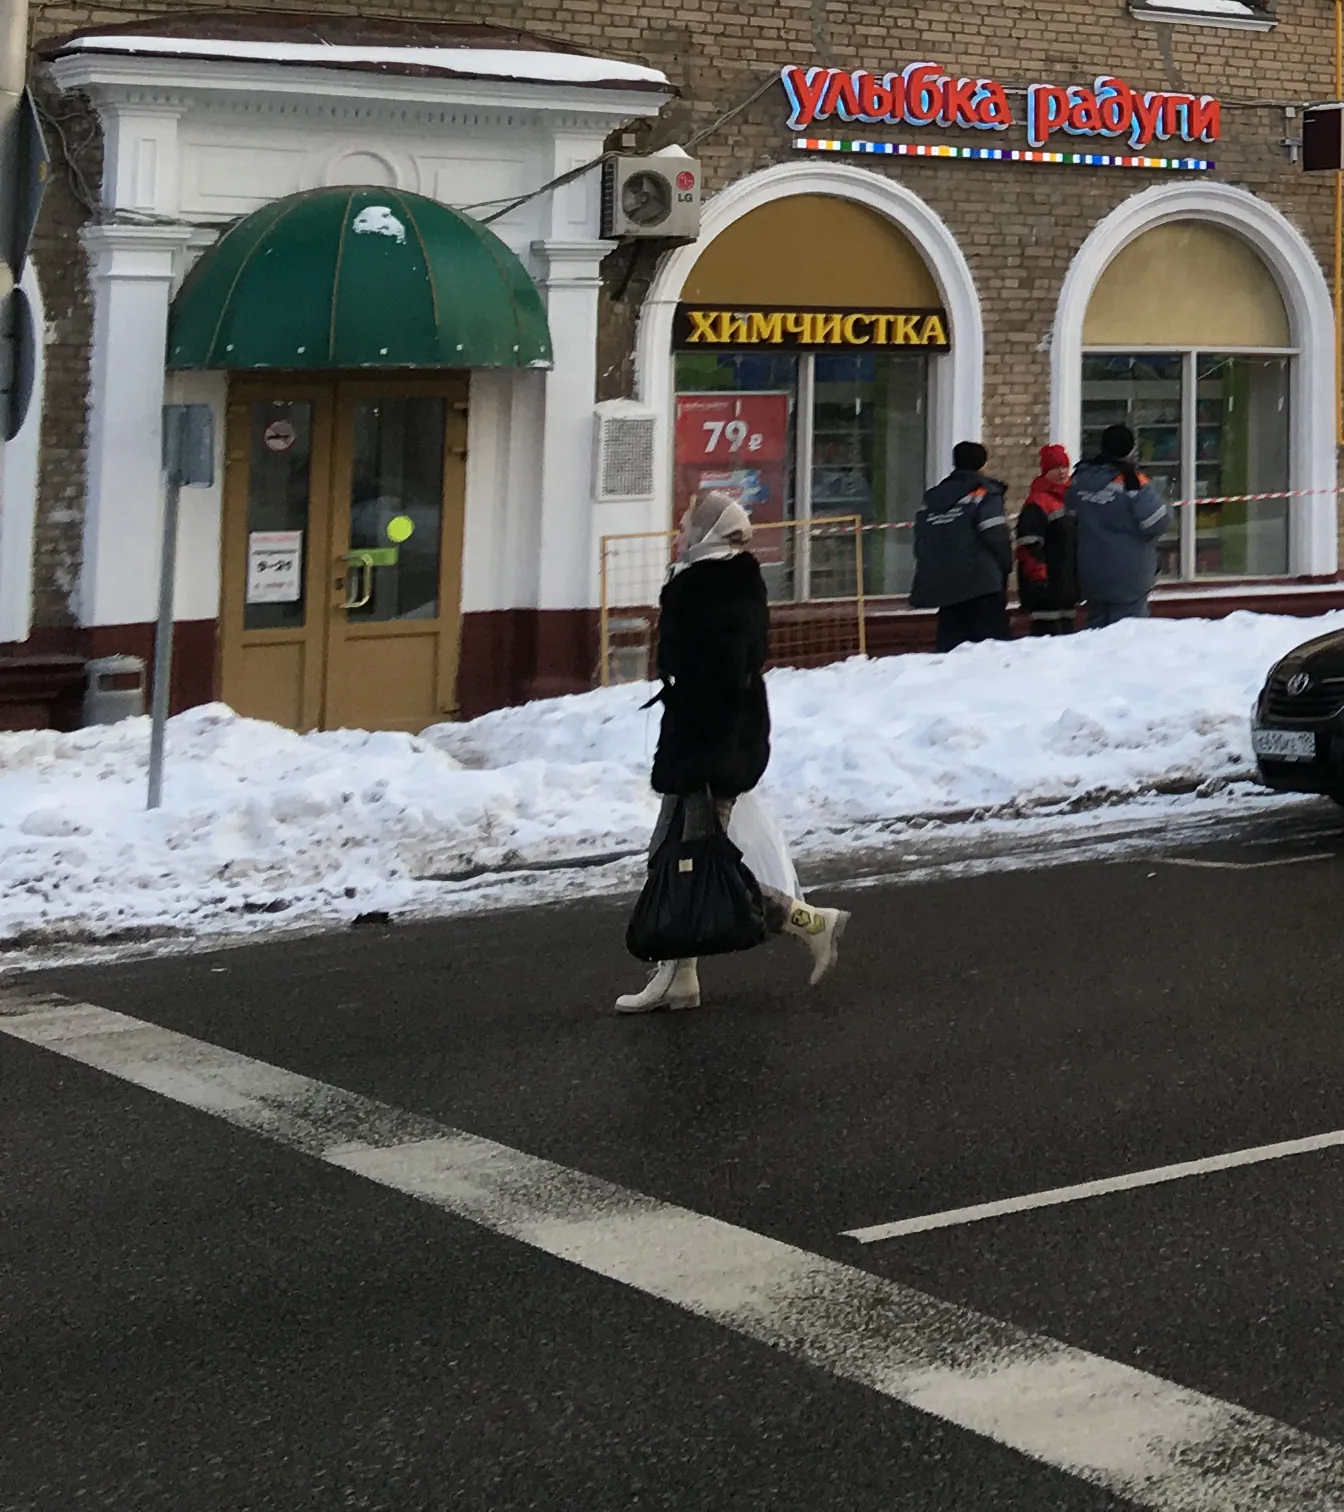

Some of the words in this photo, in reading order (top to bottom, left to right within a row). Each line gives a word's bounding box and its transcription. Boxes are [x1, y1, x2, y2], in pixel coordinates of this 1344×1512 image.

[1029, 77, 1220, 148] радуги
[677, 192, 693, 203] LG
[685, 311, 947, 345] ХИМЧИСТКА
